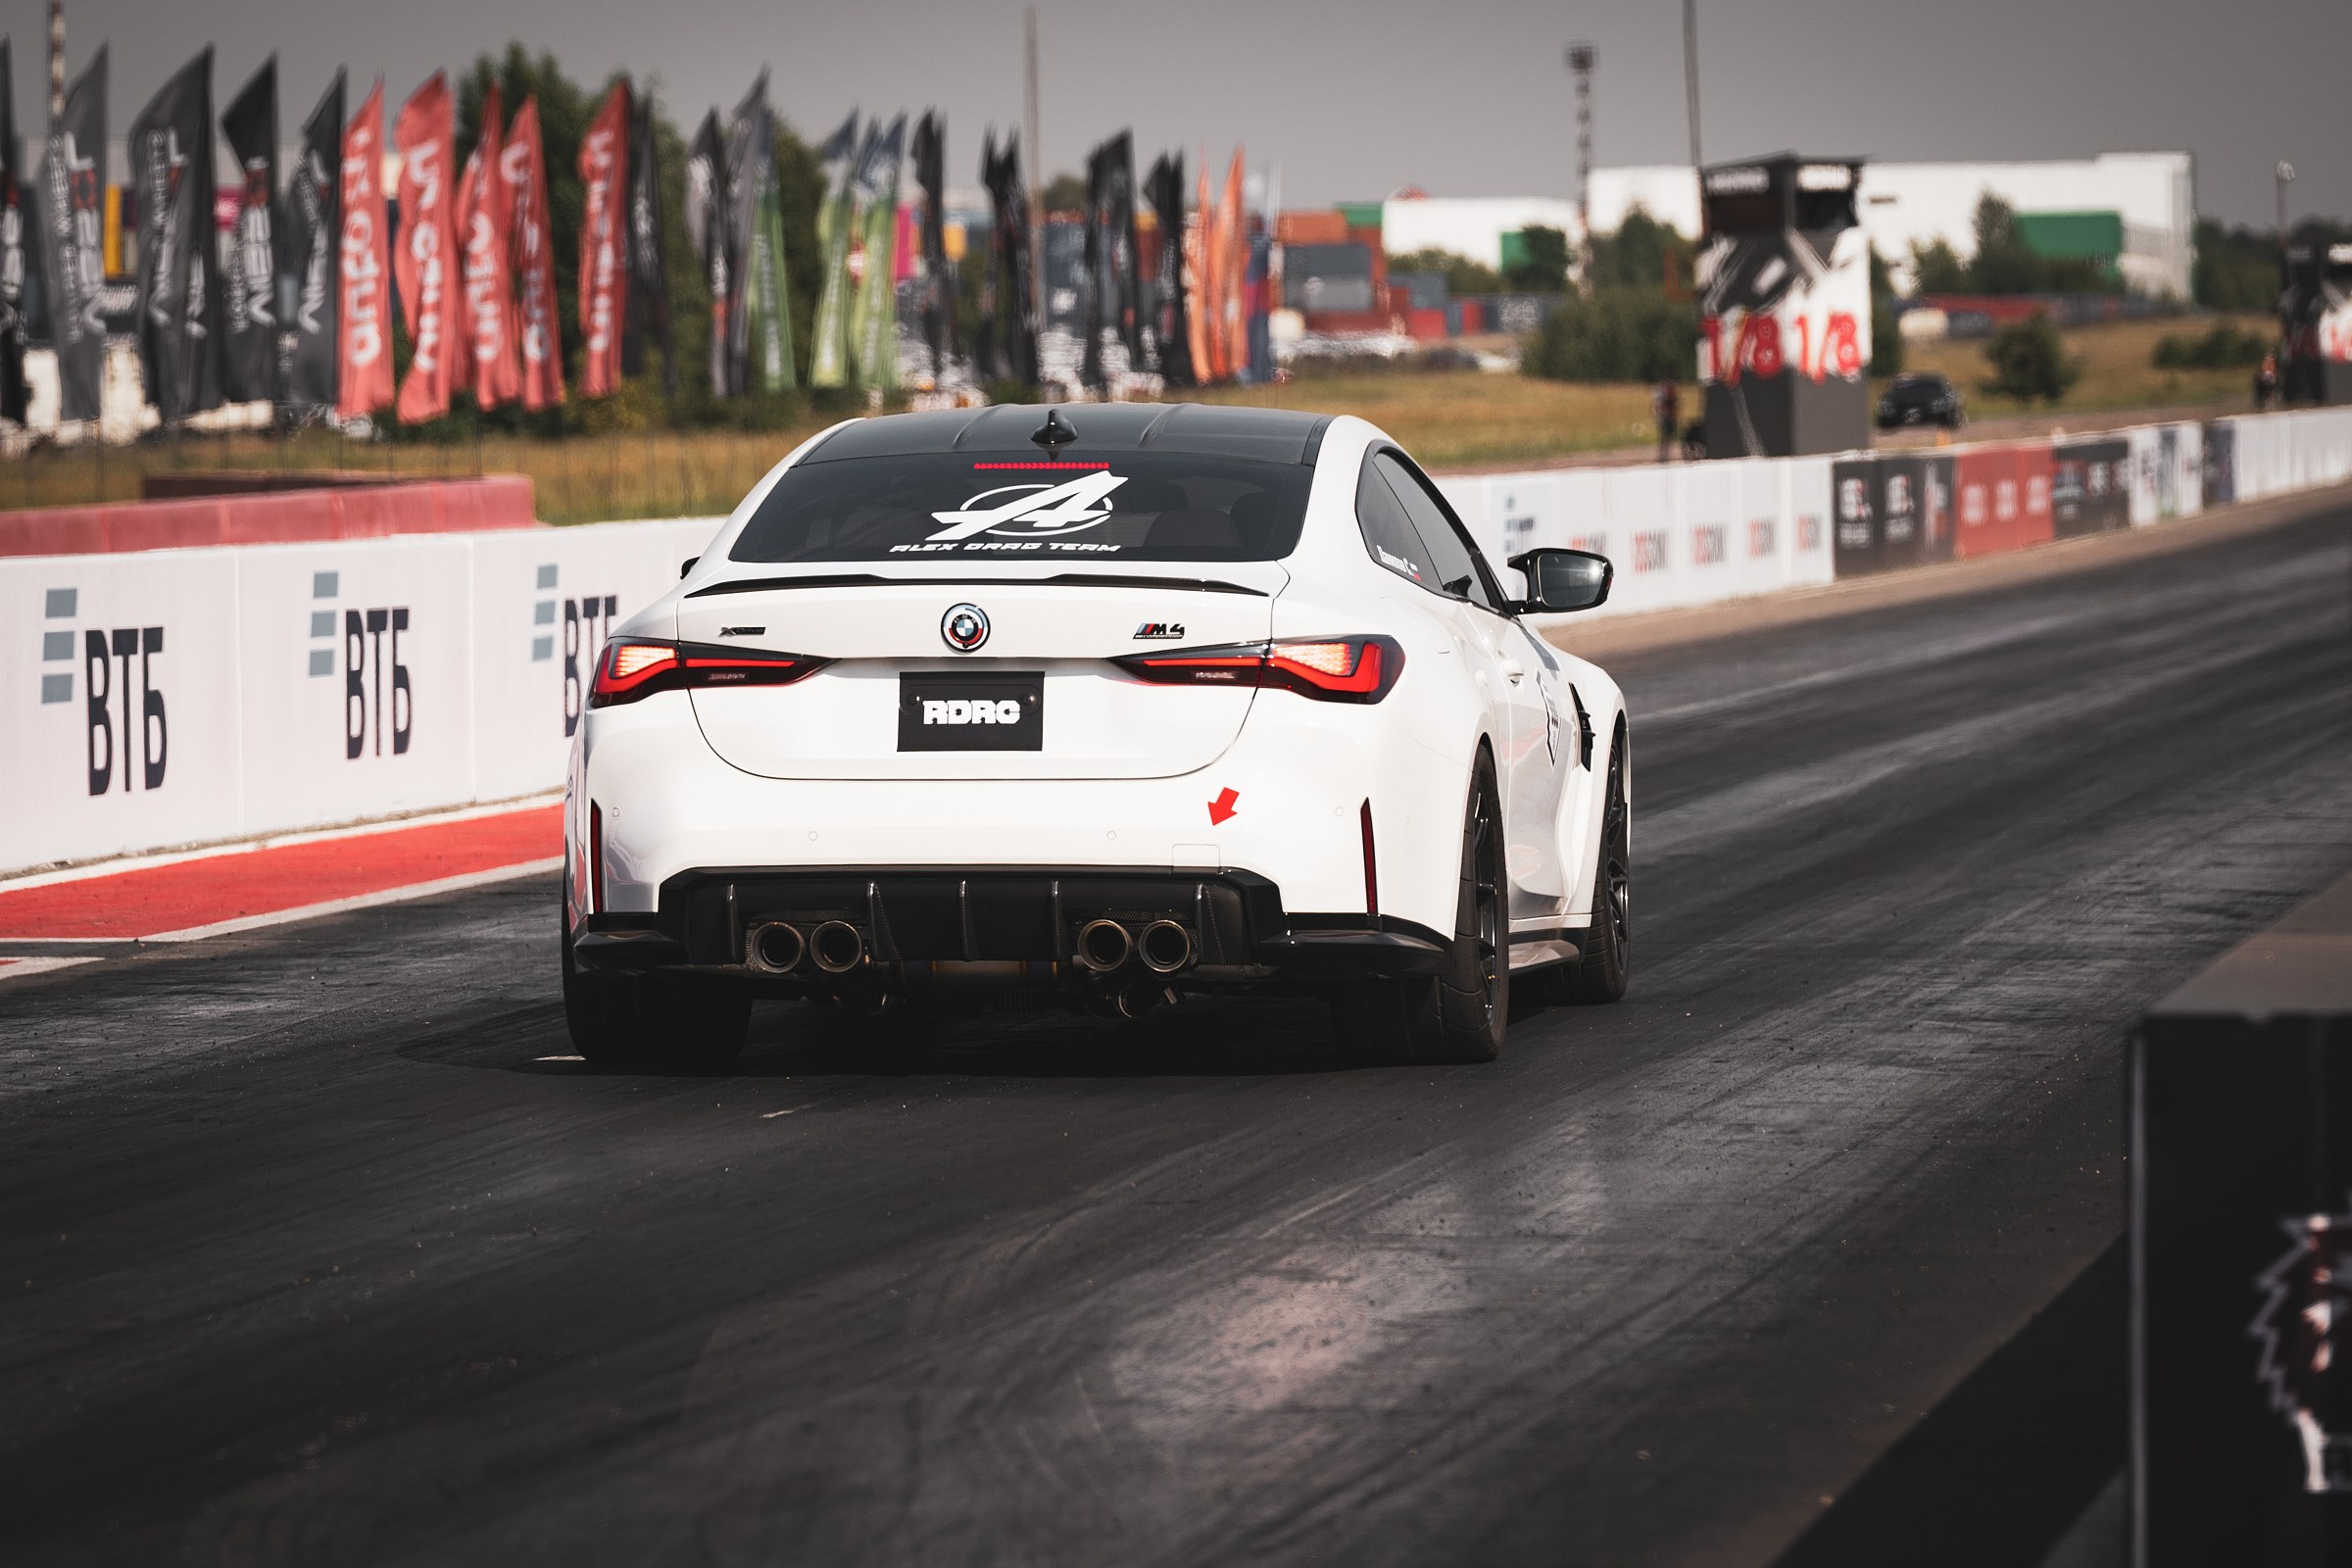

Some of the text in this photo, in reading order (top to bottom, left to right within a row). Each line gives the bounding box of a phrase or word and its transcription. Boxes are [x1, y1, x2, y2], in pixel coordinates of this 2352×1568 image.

[1795, 311, 1861, 384] 1/8
[889, 542, 1121, 553] ALEX DRAG TEAM
[1143, 623, 1185, 636] M4
[85, 626, 169, 797] ВТБ
[345, 606, 412, 760] ВТБ
